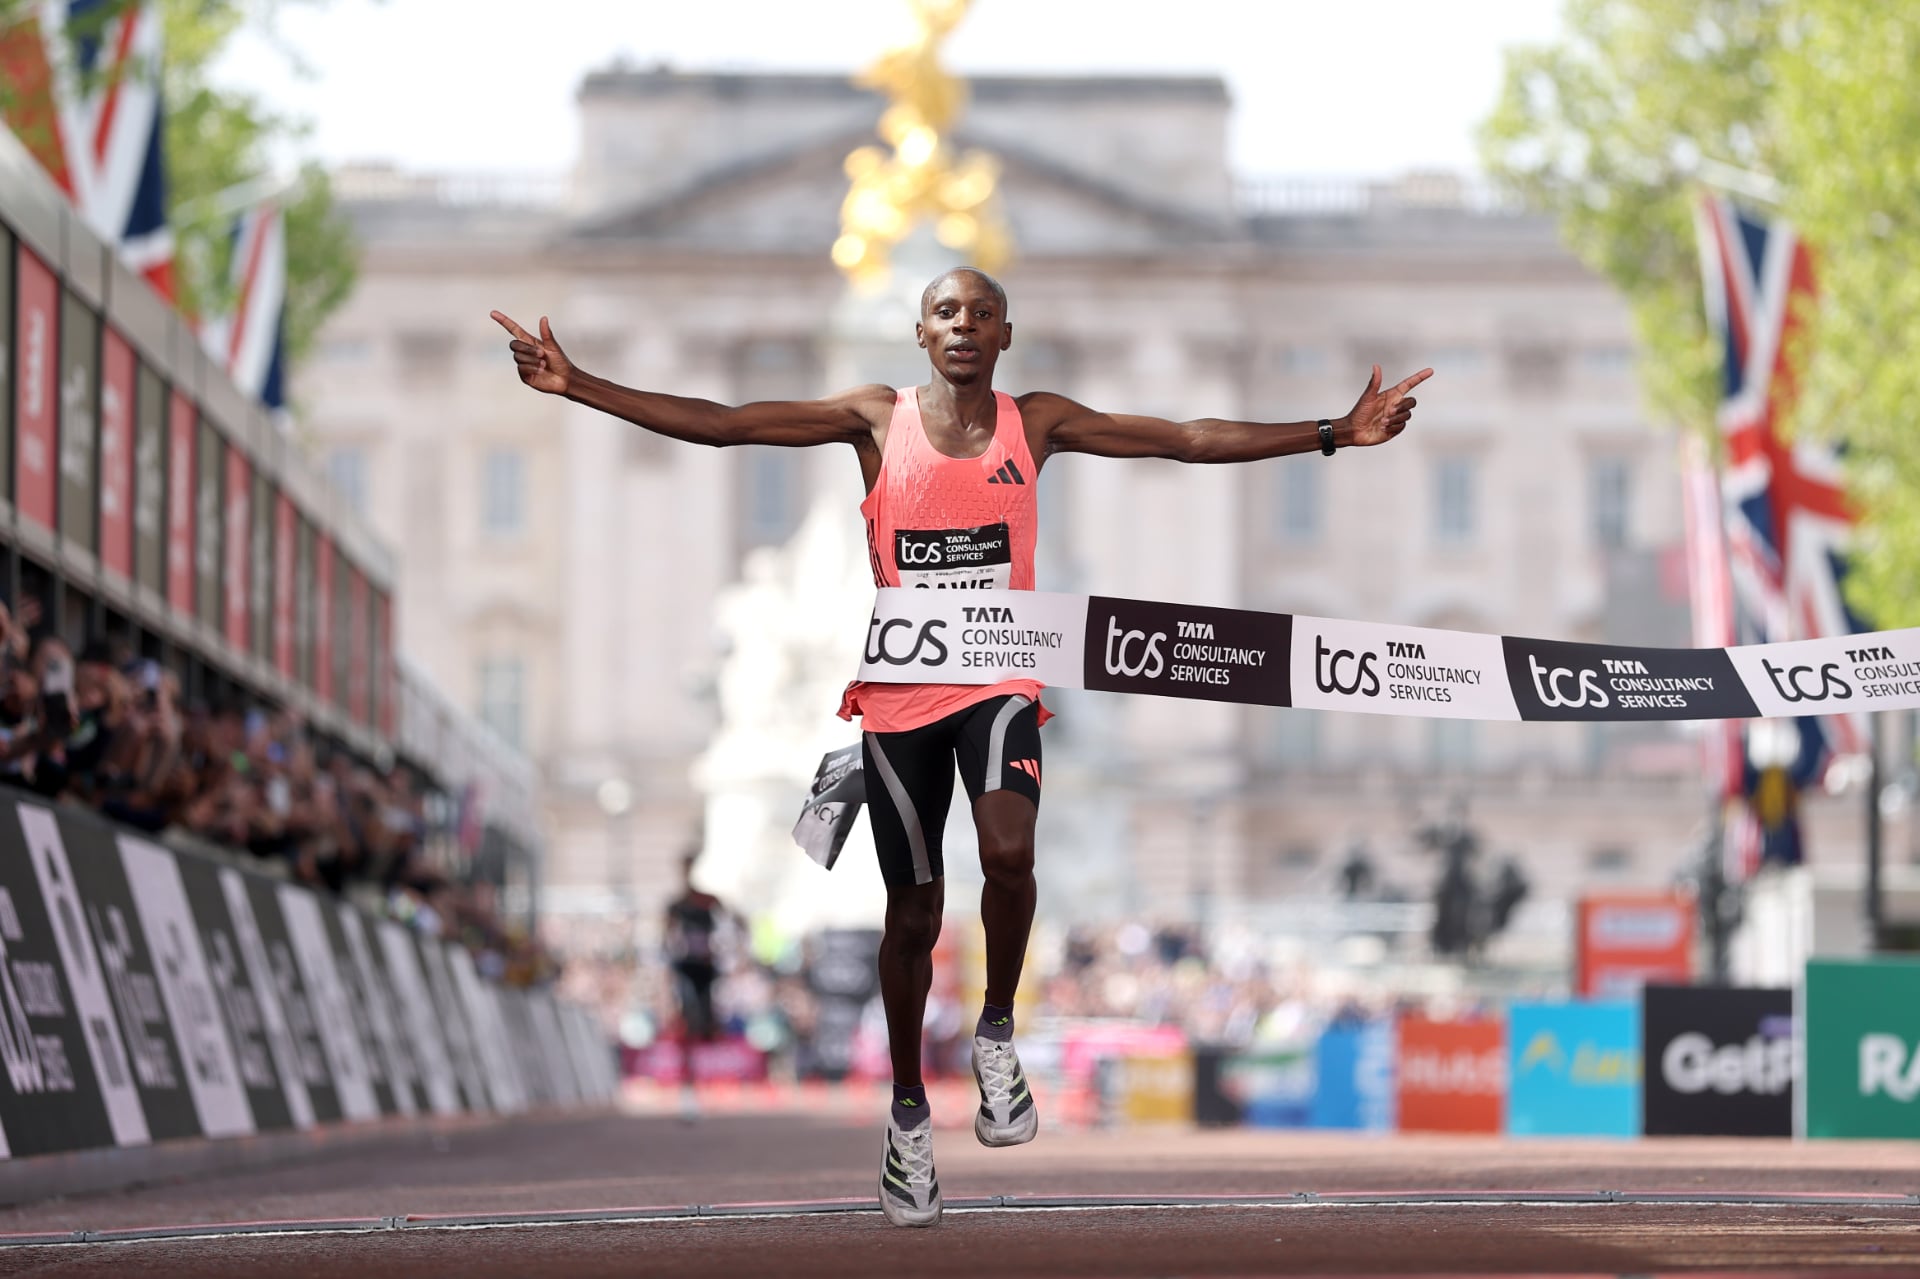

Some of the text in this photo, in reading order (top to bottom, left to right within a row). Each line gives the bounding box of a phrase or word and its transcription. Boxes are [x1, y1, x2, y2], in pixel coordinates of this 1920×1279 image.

[945, 536, 971, 544] TATA
[946, 540, 1002, 553] CONSULTANCY
[902, 537, 941, 563] tcs
[946, 552, 983, 562] SERVICES
[962, 607, 1014, 623] TATA
[864, 607, 948, 666] tcs
[962, 629, 1062, 648] CONSULTANCY
[1177, 621, 1214, 640] TATA
[1105, 615, 1167, 678] tcs
[1173, 643, 1265, 666] CONSULTANCY
[1386, 641, 1425, 659] TATA
[1845, 647, 1895, 663] TATA
[962, 651, 1036, 668] SERVICES
[1316, 635, 1380, 697] tcs
[1602, 659, 1649, 674] TATA
[1170, 664, 1230, 685] SERVICES
[1387, 663, 1481, 684] CONSULTANCY
[1528, 654, 1609, 708] tcs
[1761, 659, 1852, 702] tcs
[1389, 684, 1451, 702] SERVICES
[1610, 678, 1714, 691] CONSULTANCY
[1618, 695, 1687, 708] SERVICES
